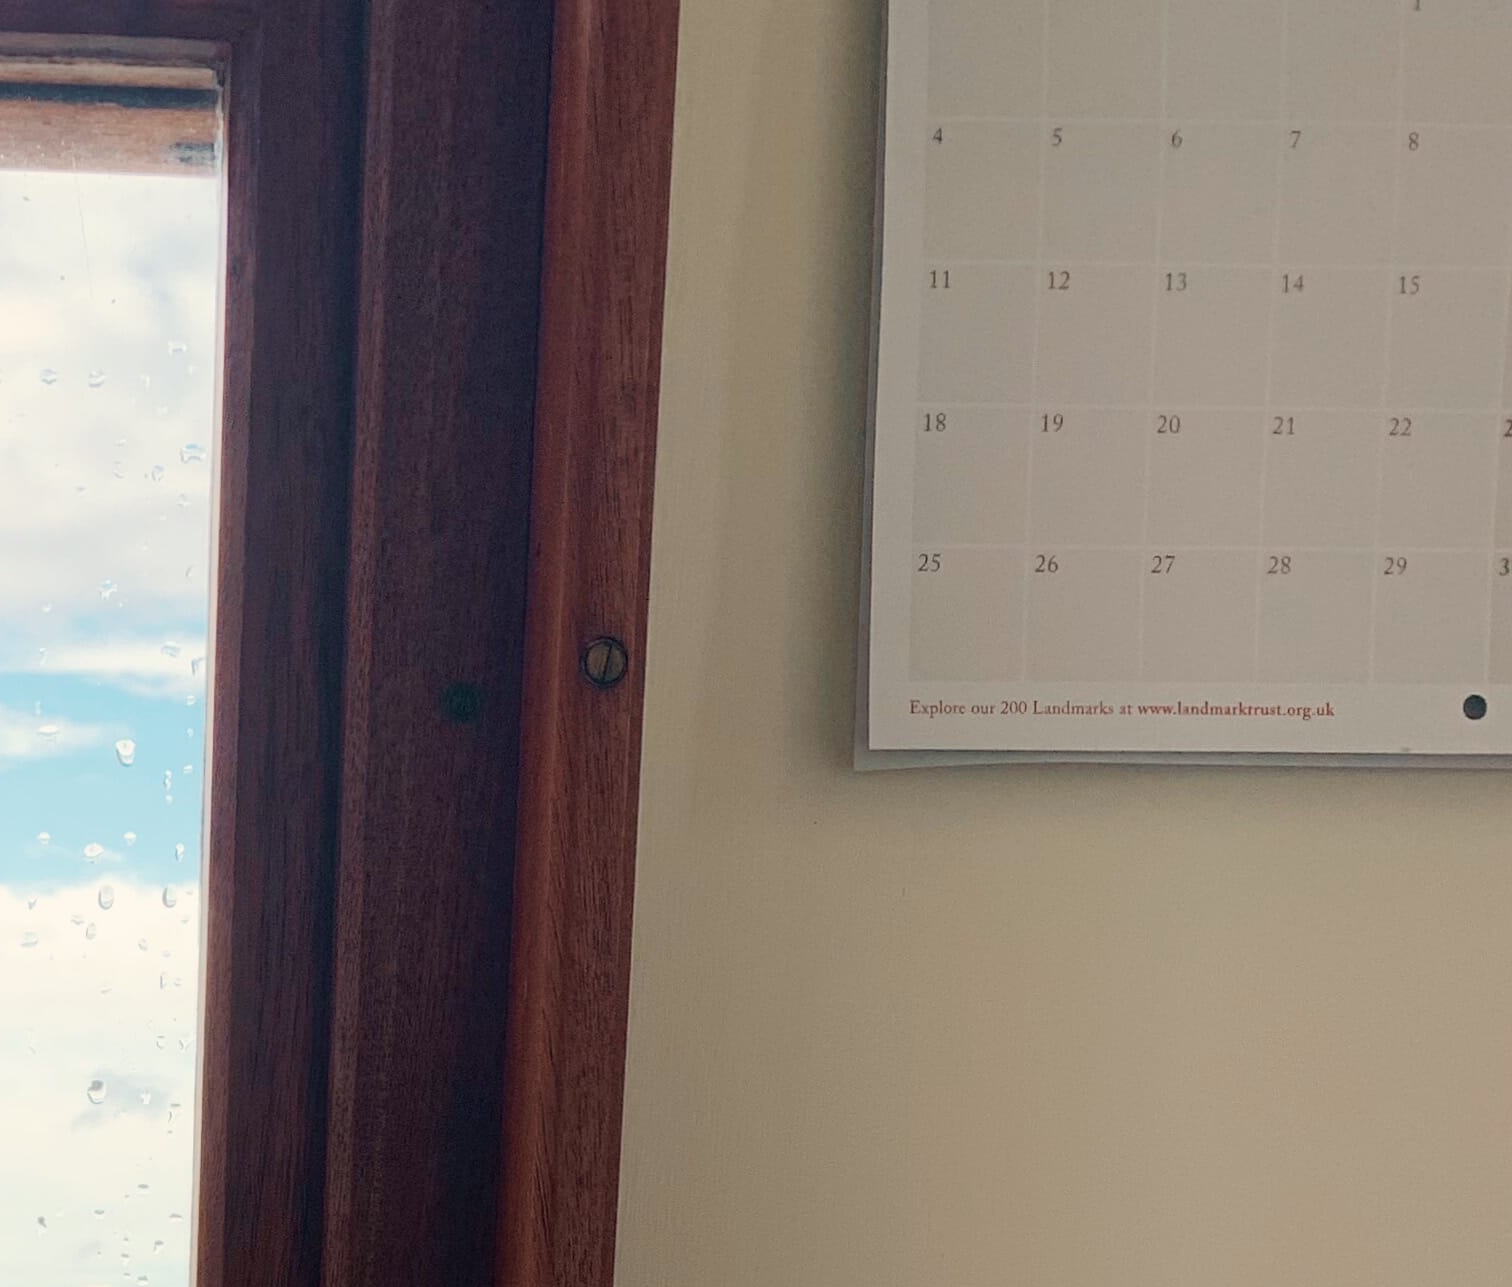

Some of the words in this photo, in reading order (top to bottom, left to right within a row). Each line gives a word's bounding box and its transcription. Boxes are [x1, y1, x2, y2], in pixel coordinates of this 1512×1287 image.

[932, 127, 944, 146] 4
[1052, 127, 1063, 147] 5
[1170, 130, 1183, 149] 6
[1290, 130, 1302, 149] 7
[1408, 131, 1420, 151] 8
[928, 269, 952, 289] 11
[1047, 270, 1071, 291] 12
[1165, 272, 1188, 292] 13
[1282, 273, 1305, 294] 14
[1398, 274, 1421, 295] 15
[923, 412, 947, 433] 18
[1041, 413, 1064, 433] 19
[1156, 414, 1181, 435] 20
[1271, 415, 1296, 436] 21
[1388, 416, 1412, 437] 22
[1502, 418, 1512, 438] 2
[917, 552, 941, 573] 25
[1034, 553, 1059, 574] 26
[1150, 554, 1176, 574] 27
[1266, 555, 1292, 575] 28
[1383, 556, 1408, 576] 29
[908, 699, 966, 719] Explore
[970, 704, 996, 716] our
[999, 700, 1028, 716] 200
[1032, 699, 1115, 716] Landmarks
[1118, 702, 1133, 716] at
[1136, 700, 1336, 721] www.landmarktrust.org.uk
